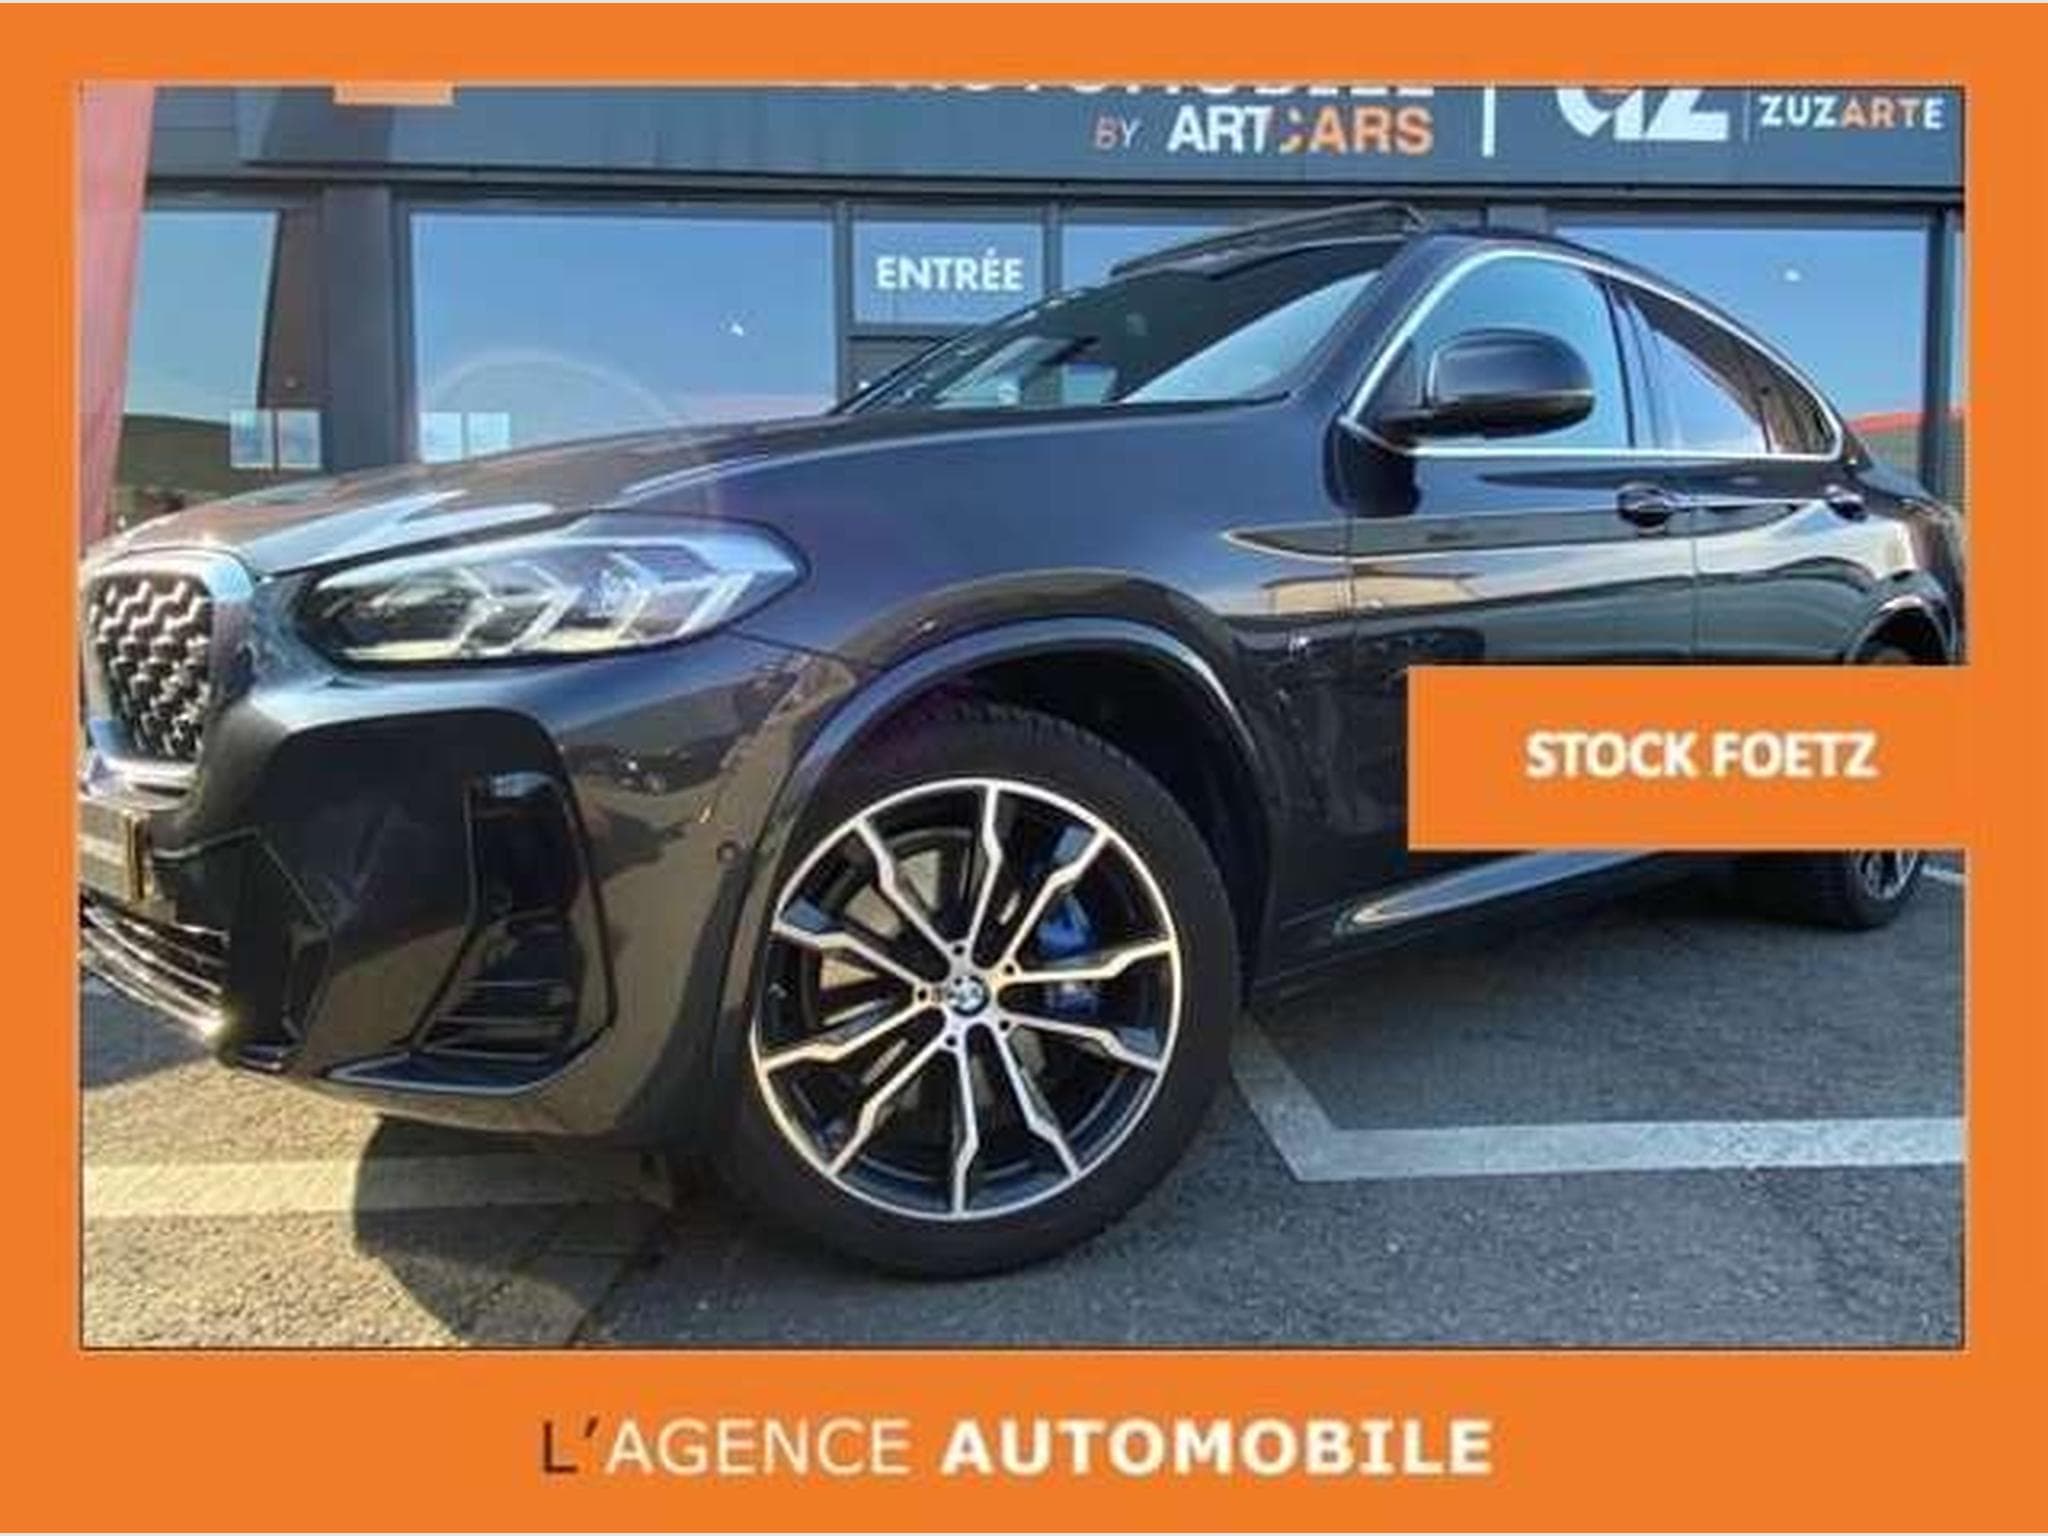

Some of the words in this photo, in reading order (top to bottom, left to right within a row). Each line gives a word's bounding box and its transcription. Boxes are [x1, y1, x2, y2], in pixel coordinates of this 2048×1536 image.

[1759, 95, 1945, 129] ZUZARTE
[1095, 116, 1141, 149] BY
[876, 247, 1024, 291] ENTRÉE
